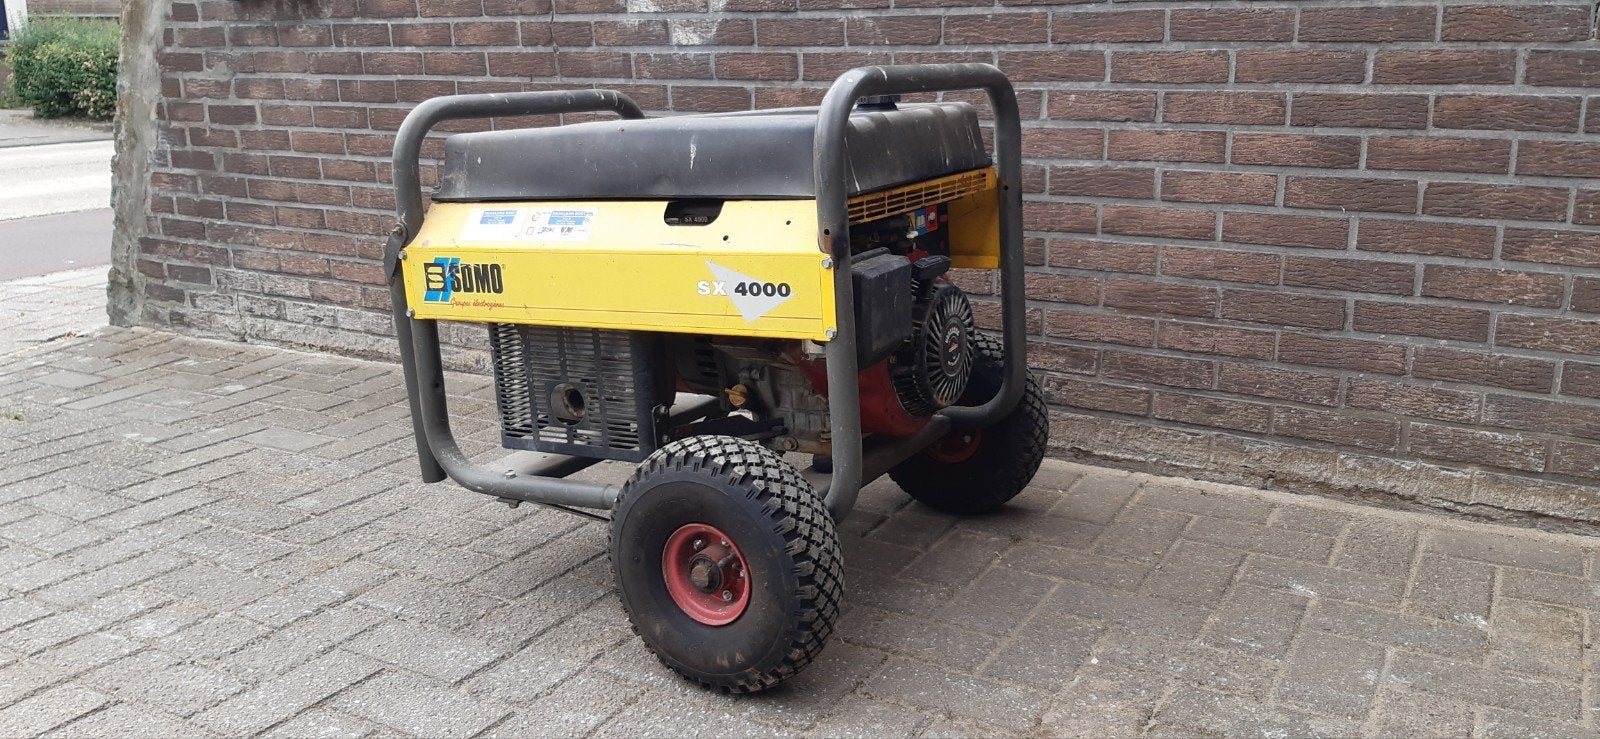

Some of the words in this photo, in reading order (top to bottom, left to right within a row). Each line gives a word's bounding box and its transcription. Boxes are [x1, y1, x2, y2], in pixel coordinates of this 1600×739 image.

[449, 263, 504, 294] SDMO
[697, 280, 727, 296] SX
[734, 281, 791, 297] 4000
